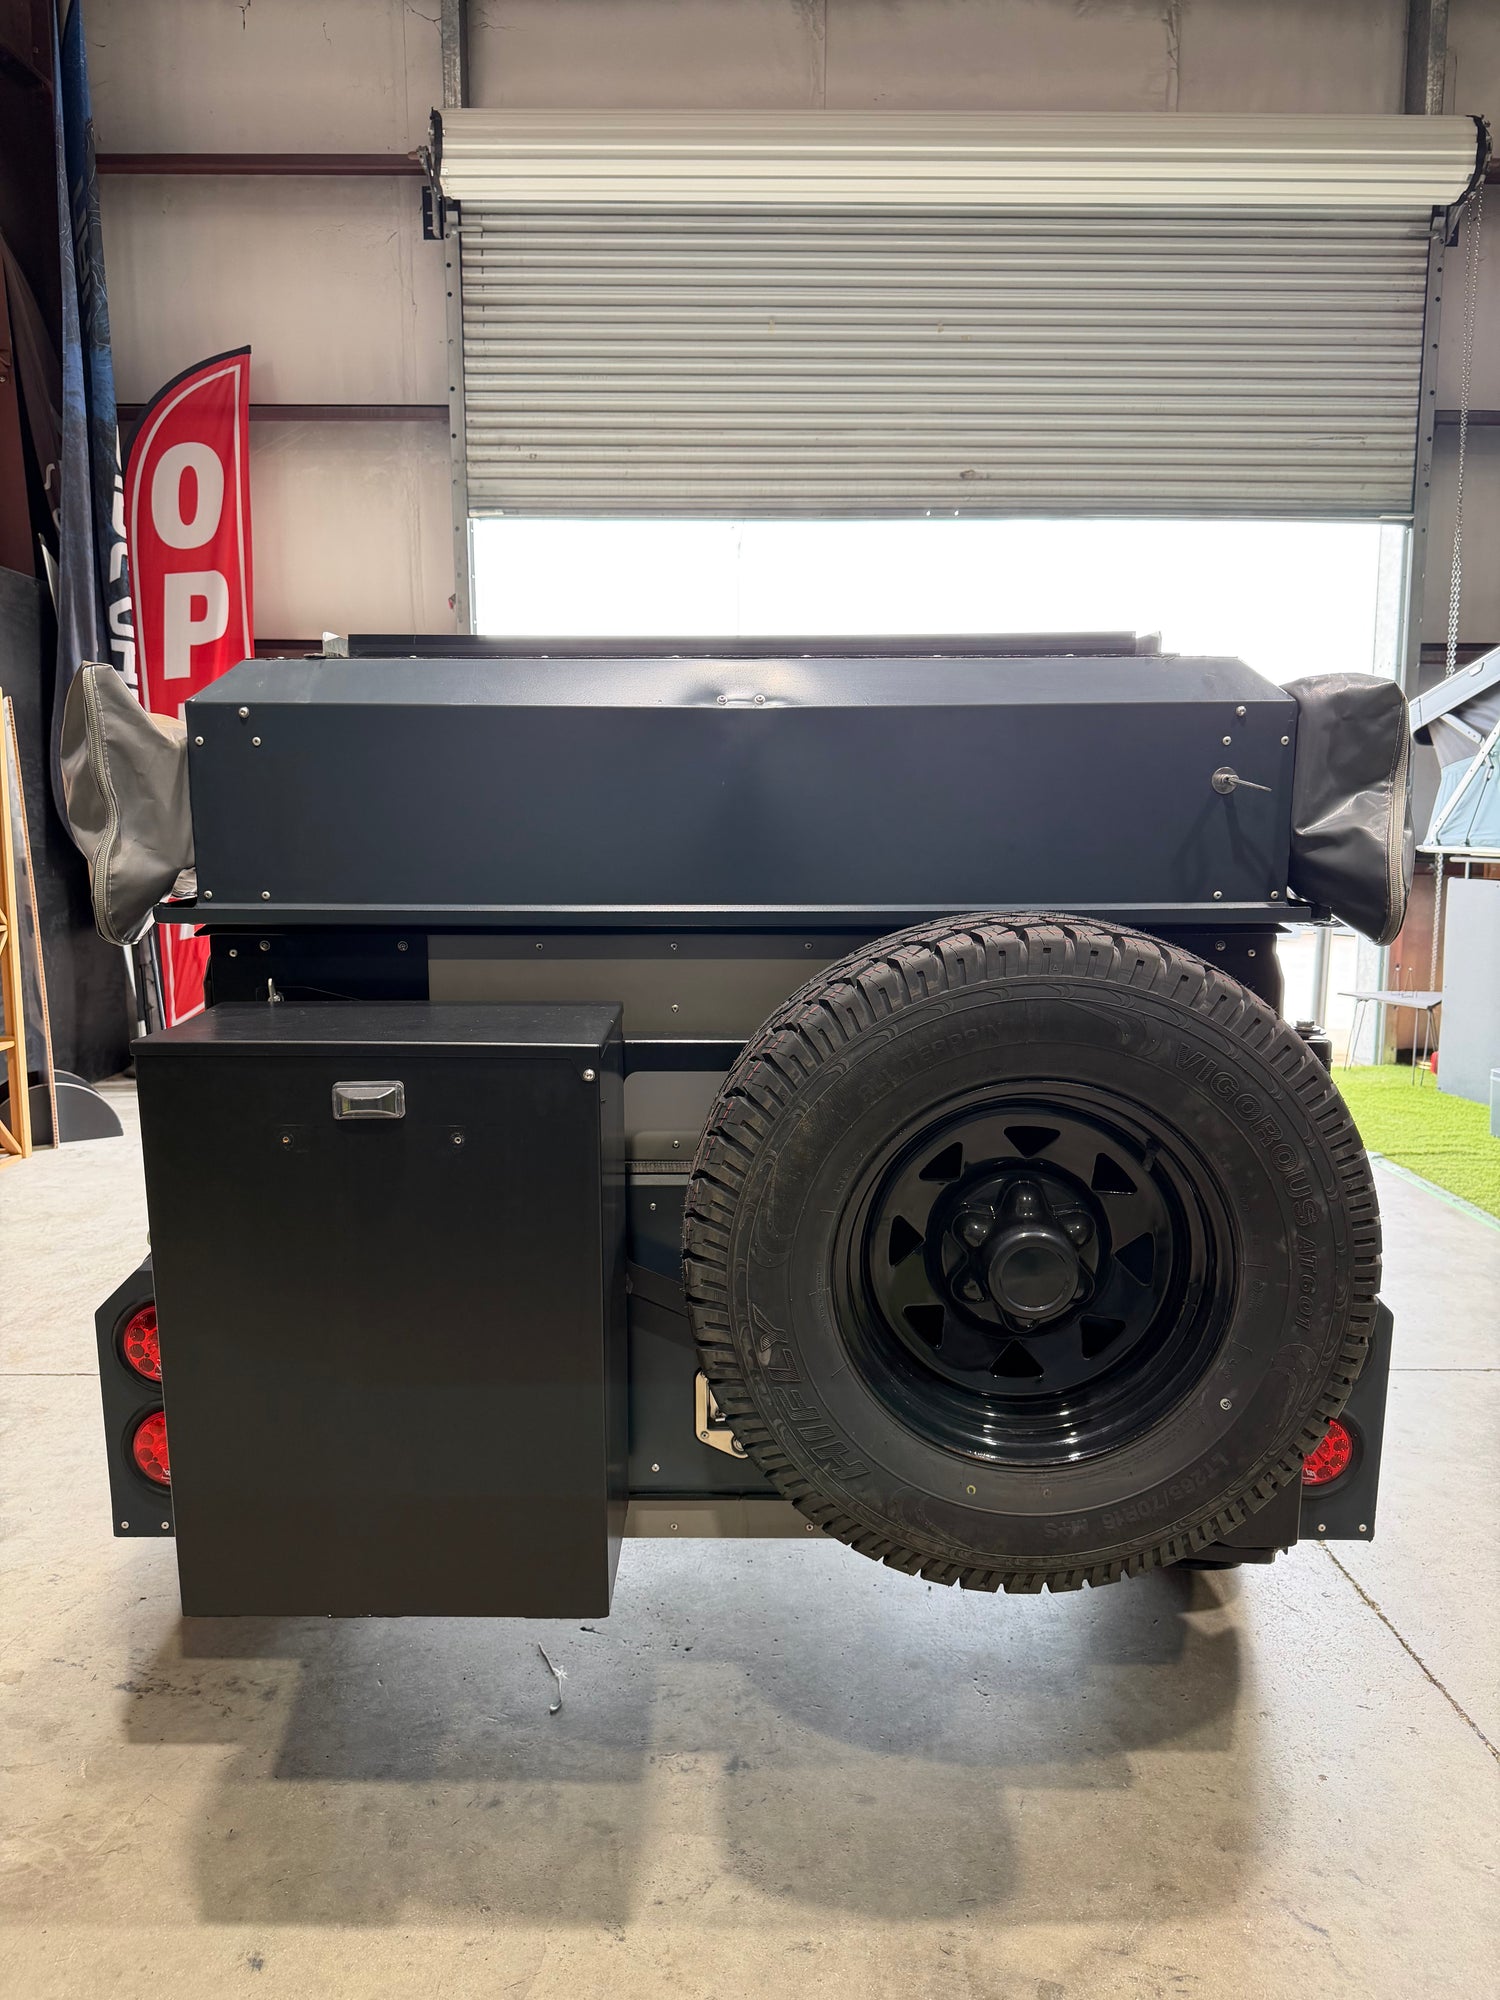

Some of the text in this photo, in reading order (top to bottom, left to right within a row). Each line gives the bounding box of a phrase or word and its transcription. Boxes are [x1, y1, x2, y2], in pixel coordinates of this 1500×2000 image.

[151, 442, 231, 717] OP
[1172, 1042, 1321, 1330] VIGOROUS AT601
[755, 1303, 871, 1480] HIFLY
[1101, 1451, 1231, 1533] LT265/70R16
